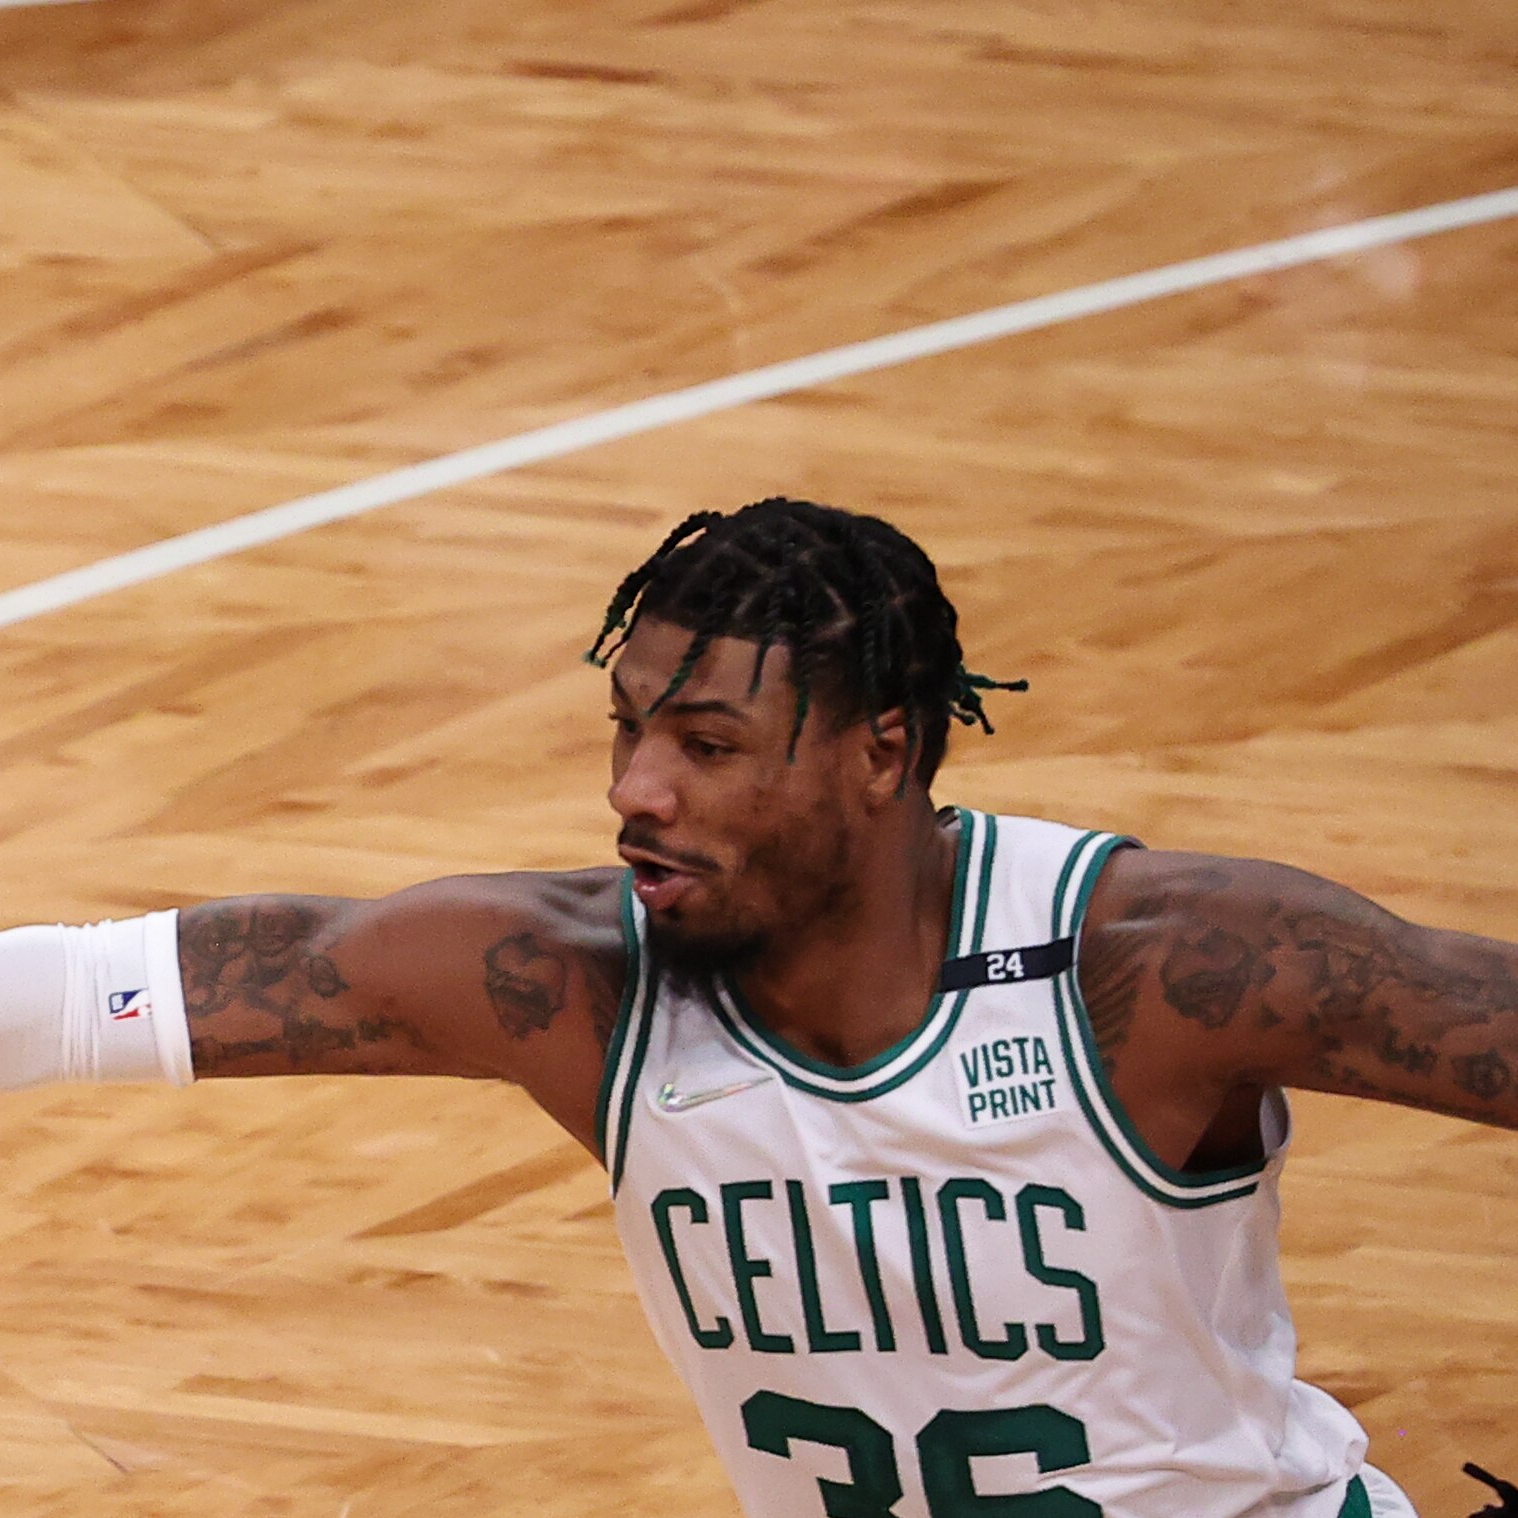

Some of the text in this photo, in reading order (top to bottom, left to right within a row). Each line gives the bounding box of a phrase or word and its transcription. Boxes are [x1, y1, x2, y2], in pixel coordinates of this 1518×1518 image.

[986, 951, 1024, 981] 24
[960, 1036, 1054, 1088] VISTA
[968, 1079, 1056, 1122] PRINT
[651, 1177, 1106, 1361] CELTICS
